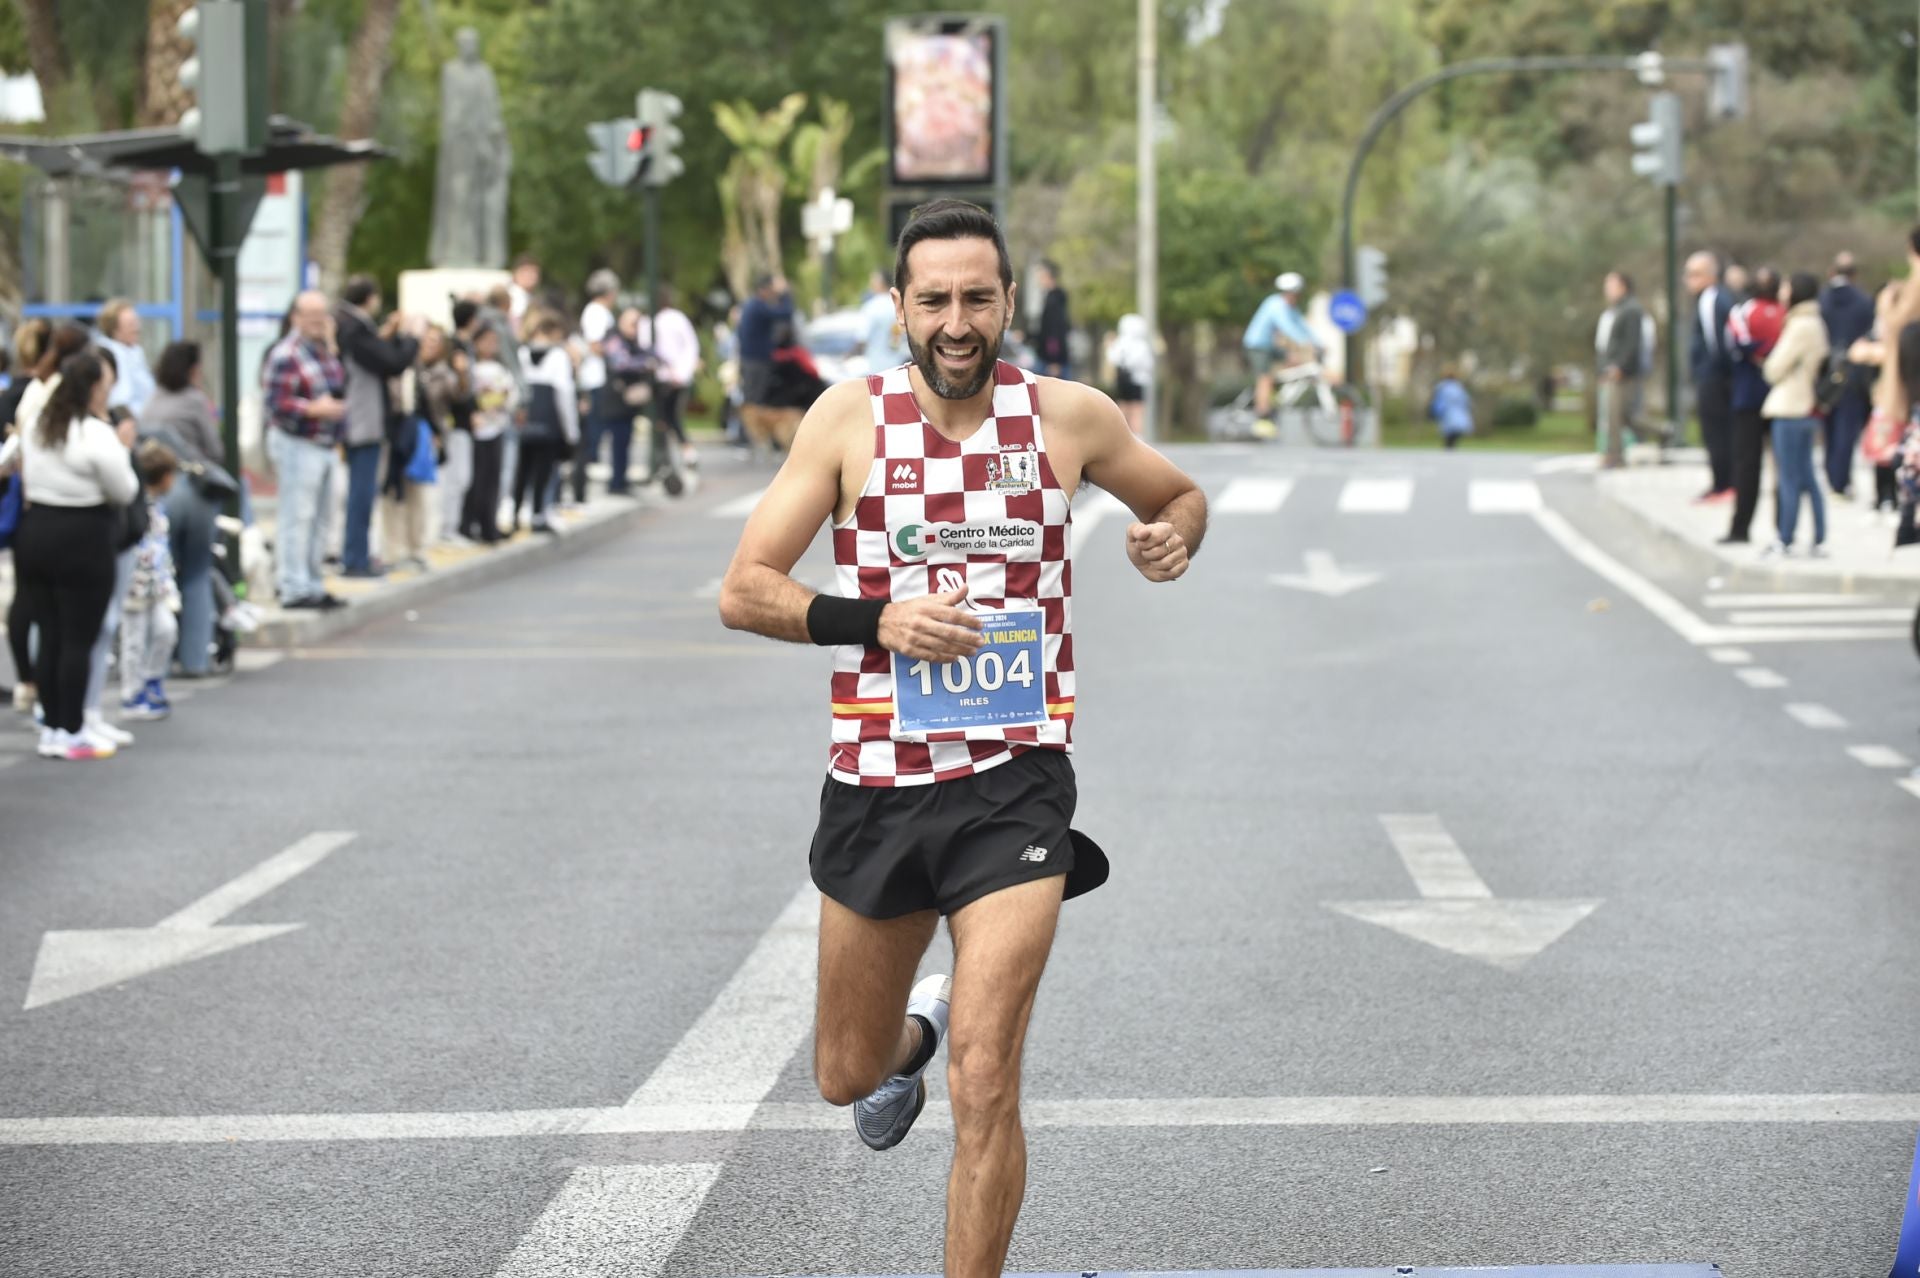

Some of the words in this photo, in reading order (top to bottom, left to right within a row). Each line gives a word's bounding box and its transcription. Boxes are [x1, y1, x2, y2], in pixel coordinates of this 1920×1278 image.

[939, 527, 985, 539] Centro
[988, 525, 1035, 537] Médico
[940, 540, 972, 550] Virgen
[974, 540, 986, 549] de
[988, 540, 997, 548] la
[999, 538, 1035, 548] Caridad
[992, 630, 1037, 644] VALENCIA
[909, 649, 1034, 696] 1004
[960, 697, 989, 707] IRLES
